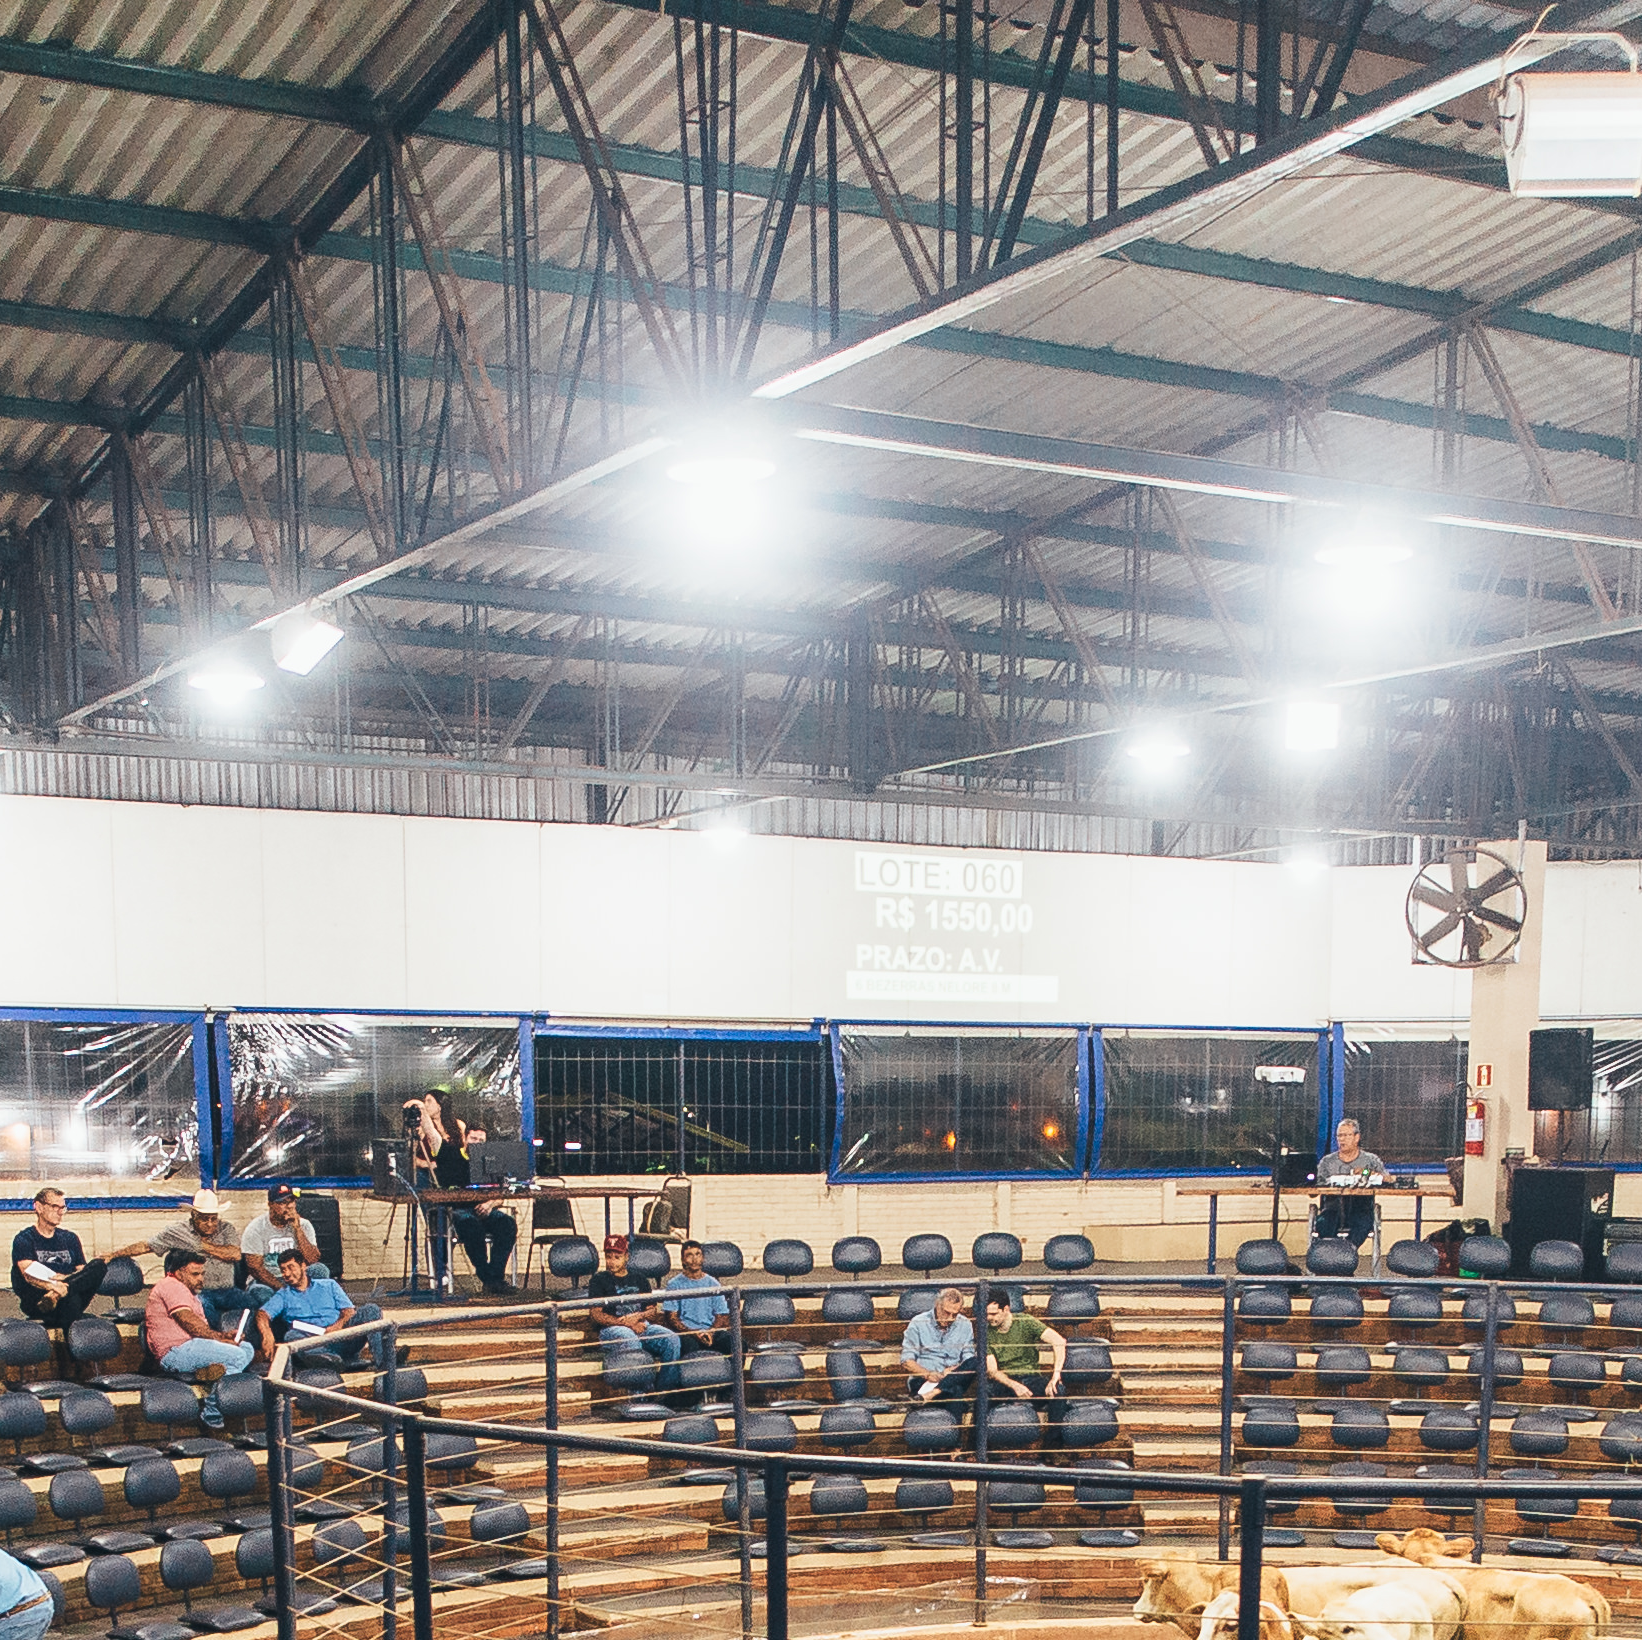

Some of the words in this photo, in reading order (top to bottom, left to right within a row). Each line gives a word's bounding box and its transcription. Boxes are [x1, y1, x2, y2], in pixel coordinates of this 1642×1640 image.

[859, 857, 950, 890] LOTE:
[963, 861, 1015, 894] 060
[876, 896, 915, 932] R$
[925, 900, 1034, 937] 1550,00
[856, 944, 953, 972] PRAZO:
[958, 947, 1004, 973] A.V.
[866, 979, 935, 993] BEZERRAS
[938, 981, 988, 994] NELORE
